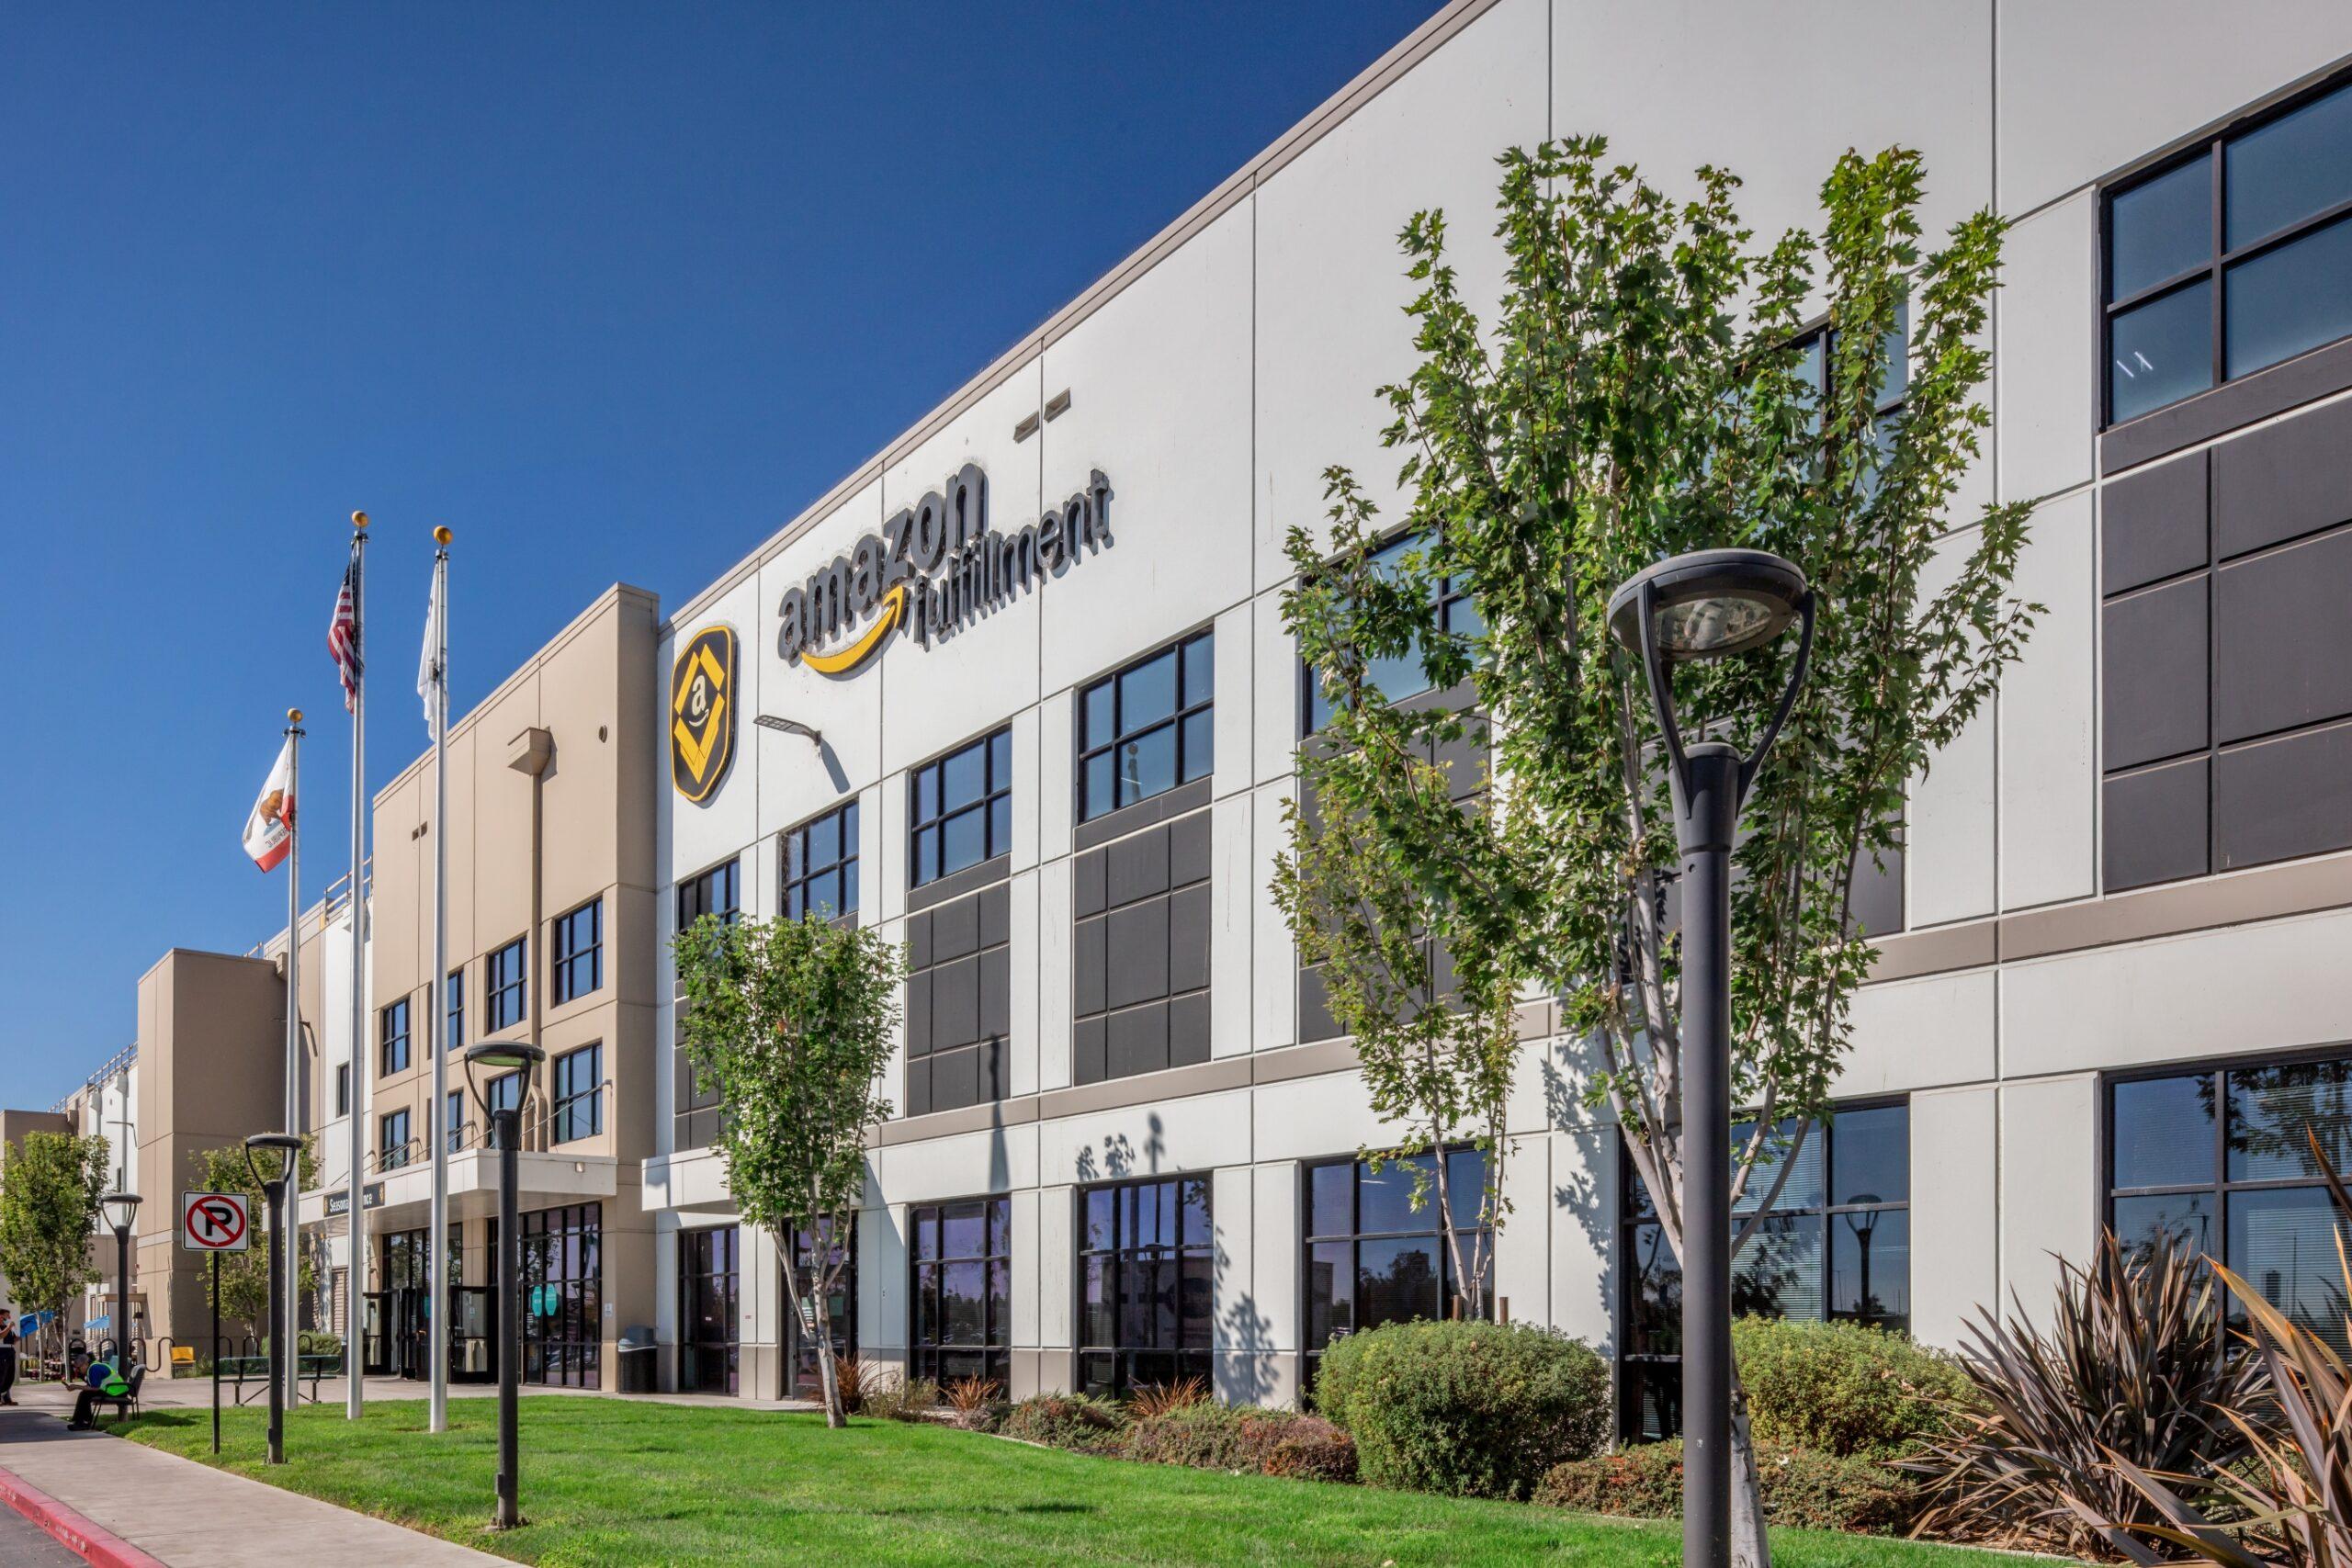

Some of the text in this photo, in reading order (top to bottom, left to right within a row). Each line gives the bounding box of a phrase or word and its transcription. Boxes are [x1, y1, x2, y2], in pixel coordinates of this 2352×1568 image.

[777, 463, 984, 661] amazon
[913, 468, 1110, 644] fulfillment
[692, 675, 707, 716] a
[205, 1206, 232, 1236] P
[329, 1198, 350, 1213] Seasona
